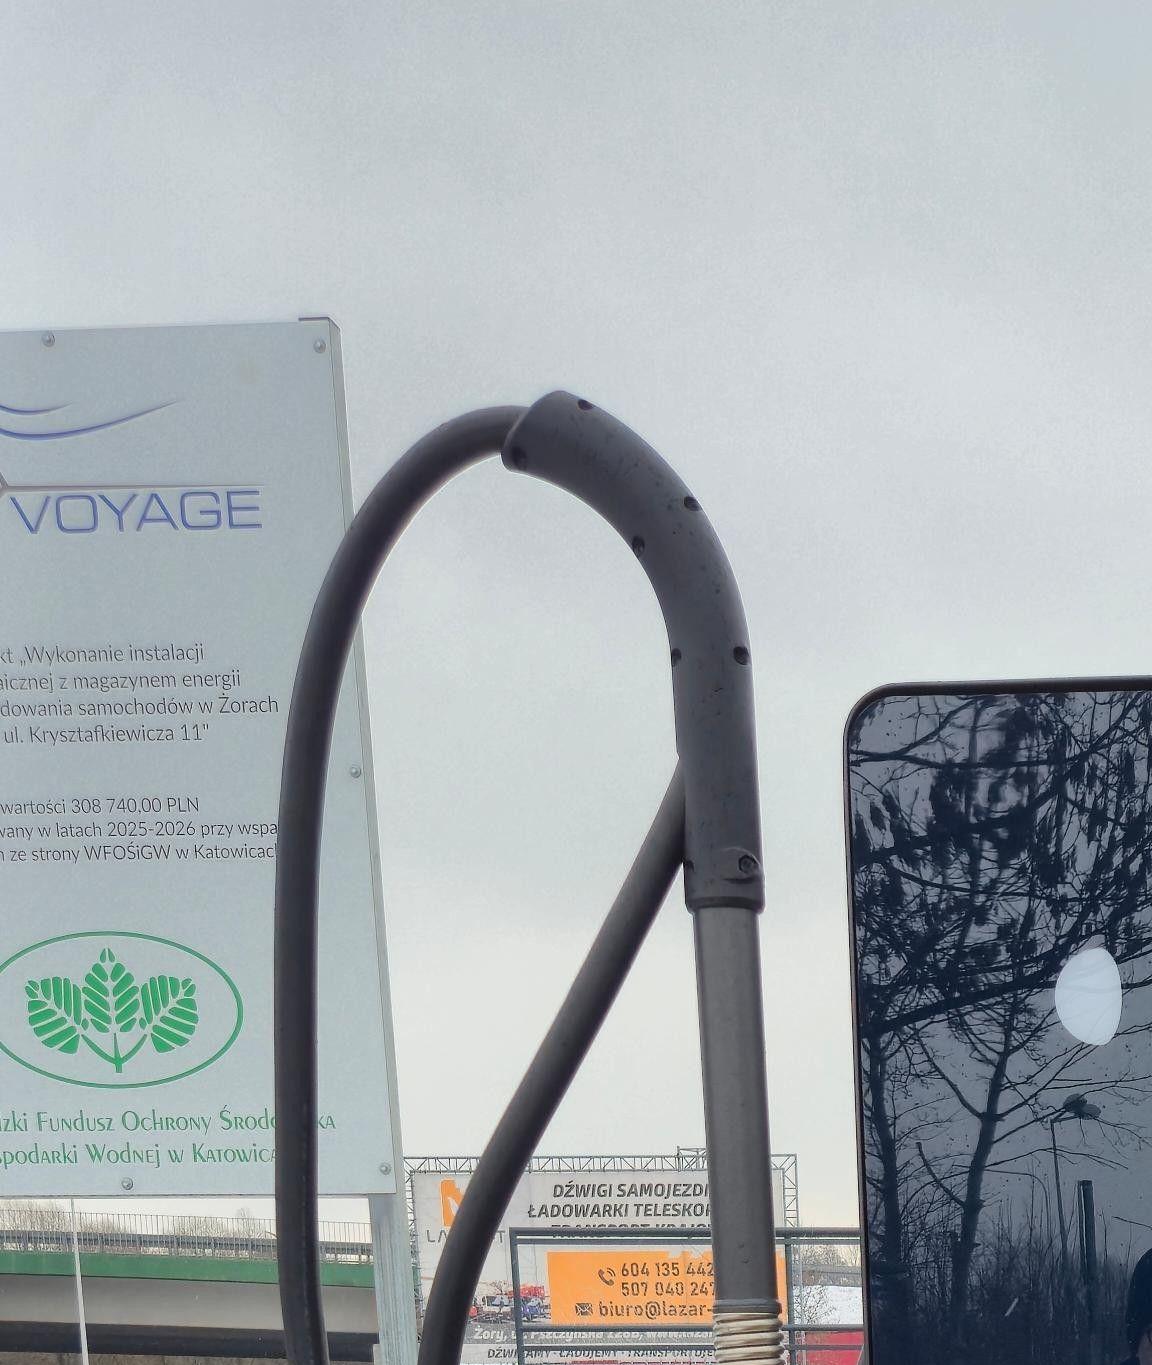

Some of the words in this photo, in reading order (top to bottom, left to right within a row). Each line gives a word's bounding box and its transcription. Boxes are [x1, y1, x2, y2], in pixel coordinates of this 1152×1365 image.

[10, 490, 263, 534] VOYAGE
[130, 643, 204, 664] instalacji
[59, 677, 69, 690] z
[73, 674, 176, 693] magazynem
[182, 669, 241, 690] energii
[78, 697, 193, 716] samochodów
[198, 701, 213, 714] w
[218, 692, 279, 714] Żorach
[4, 726, 24, 743] ul.
[0, 798, 66, 815] wartości
[71, 798, 102, 814] 308
[167, 796, 199, 813] PLN
[37, 826, 51, 838] w
[56, 821, 102, 838] latach
[107, 820, 196, 837] 2025-2026
[201, 823, 234, 839] przy
[237, 823, 278, 838] wspa
[9, 849, 27, 862] ze
[31, 847, 80, 865] strony
[83, 841, 171, 861] WFOŚiGW
[175, 848, 189, 859] w
[0, 1109, 28, 1132] zki
[552, 1180, 613, 1198] DŹWIGI
[616, 1183, 709, 1199] SAMOJEZD
[527, 1203, 629, 1218] ŁADOWARKI
[633, 1203, 709, 1217] TELESKO
[621, 1262, 650, 1277] 604
[655, 1262, 680, 1276] 135
[621, 1282, 649, 1297] 507
[655, 1282, 684, 1297] 040
